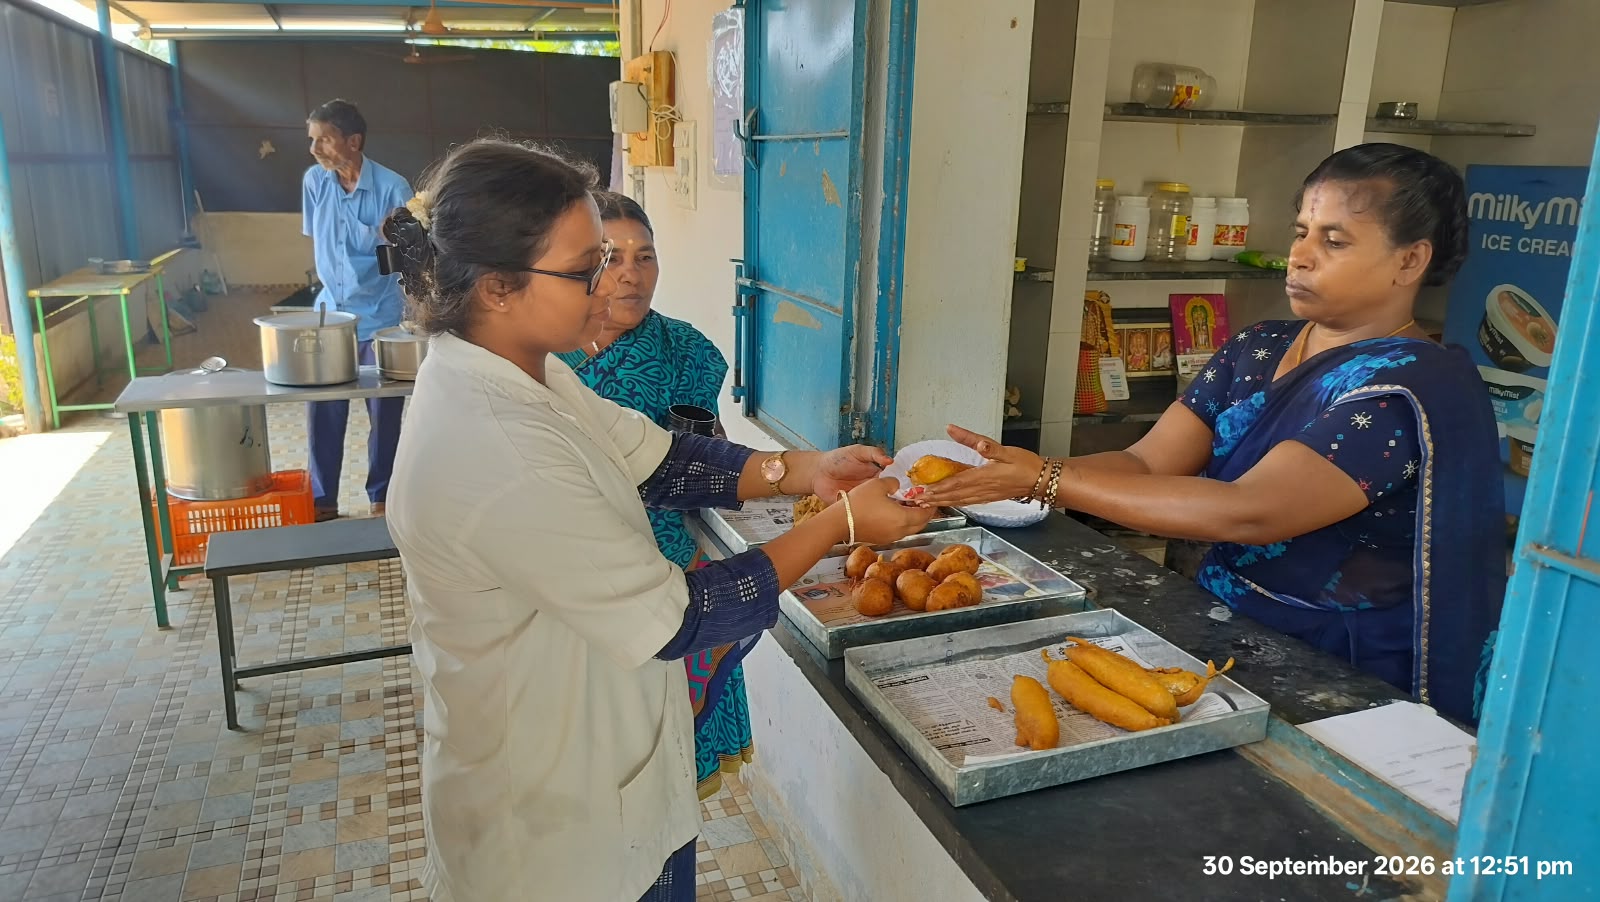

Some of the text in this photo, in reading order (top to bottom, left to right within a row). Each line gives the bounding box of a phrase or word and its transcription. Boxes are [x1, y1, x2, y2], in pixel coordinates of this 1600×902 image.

[1467, 192, 1585, 230] MilkyMi
[1482, 233, 1576, 257] ICE CREA
